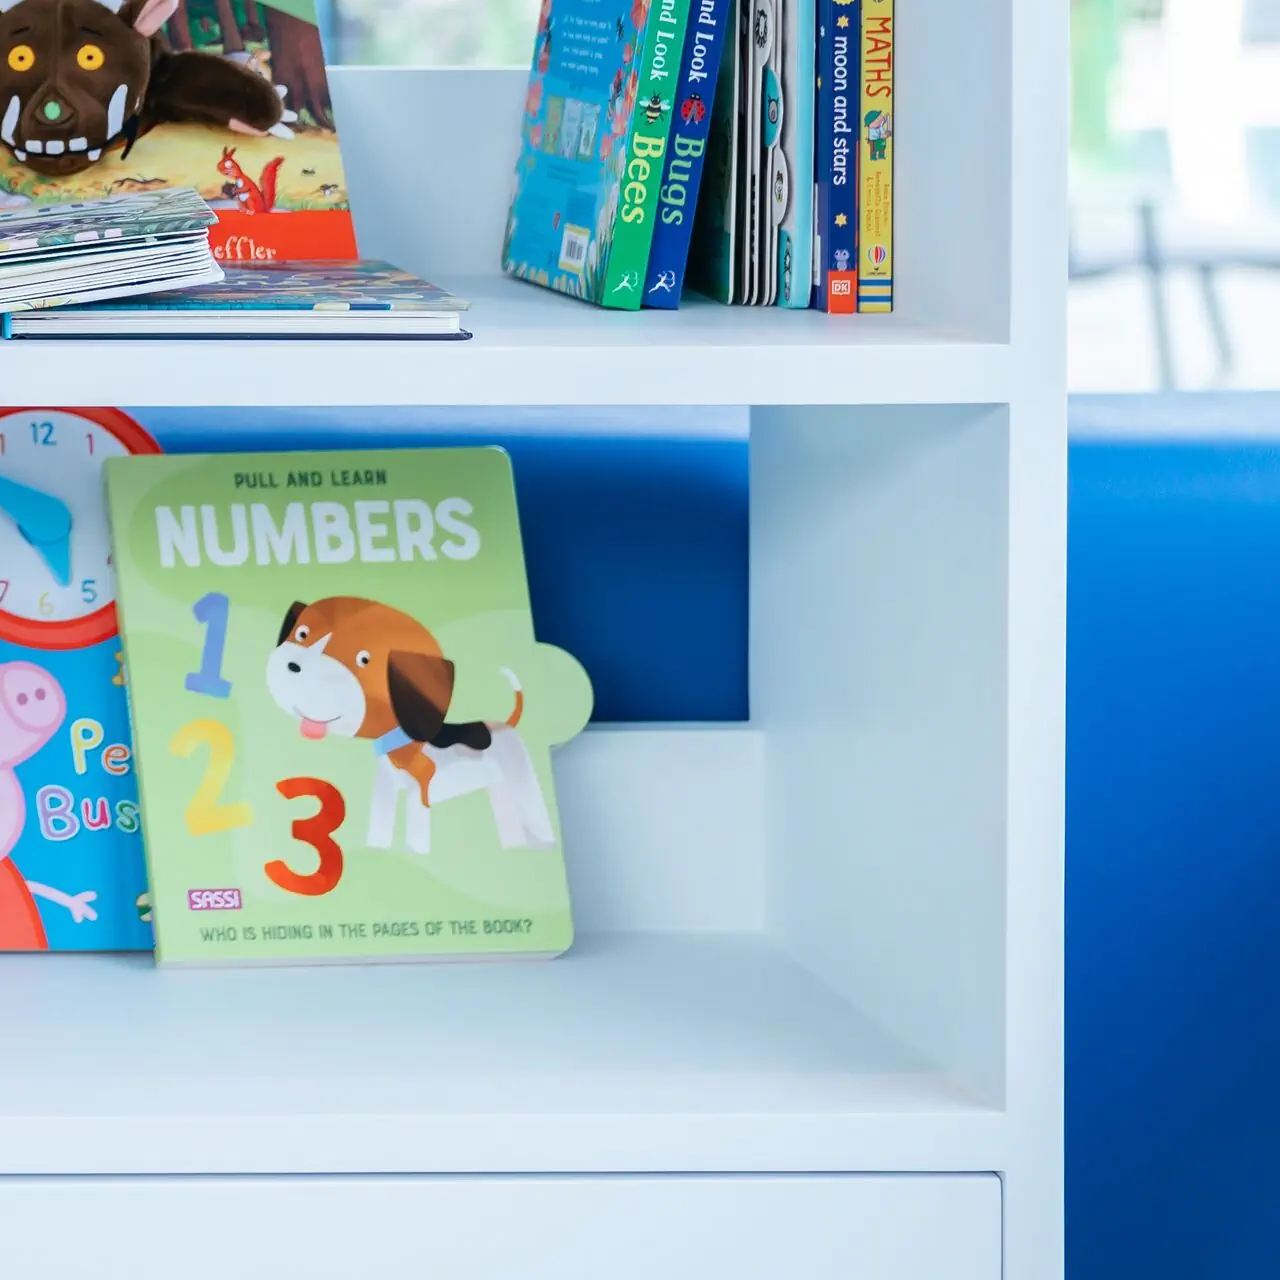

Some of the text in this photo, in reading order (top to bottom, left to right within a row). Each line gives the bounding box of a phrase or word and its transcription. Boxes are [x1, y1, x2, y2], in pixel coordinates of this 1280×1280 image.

[649, 29, 676, 82] Look
[687, 31, 715, 84] Look
[865, 16, 893, 98] MATHS
[833, 36, 852, 186] moon and stars
[621, 131, 666, 225] Bees
[660, 133, 706, 226] Bugs
[213, 236, 277, 260] effler
[29, 421, 58, 446] 12
[85, 432, 95, 456] 1
[234, 469, 387, 489] PULL AND LEARN
[154, 497, 481, 569] NUMBERS
[38, 592, 54, 616] 6
[81, 579, 98, 604] 5
[184, 591, 233, 700] 1
[168, 718, 255, 837] 2
[263, 776, 346, 897] 3
[191, 891, 240, 908] SASSI
[199, 918, 533, 942] WHO IS HIDING IN THE PAGES OF THE BOOK?
